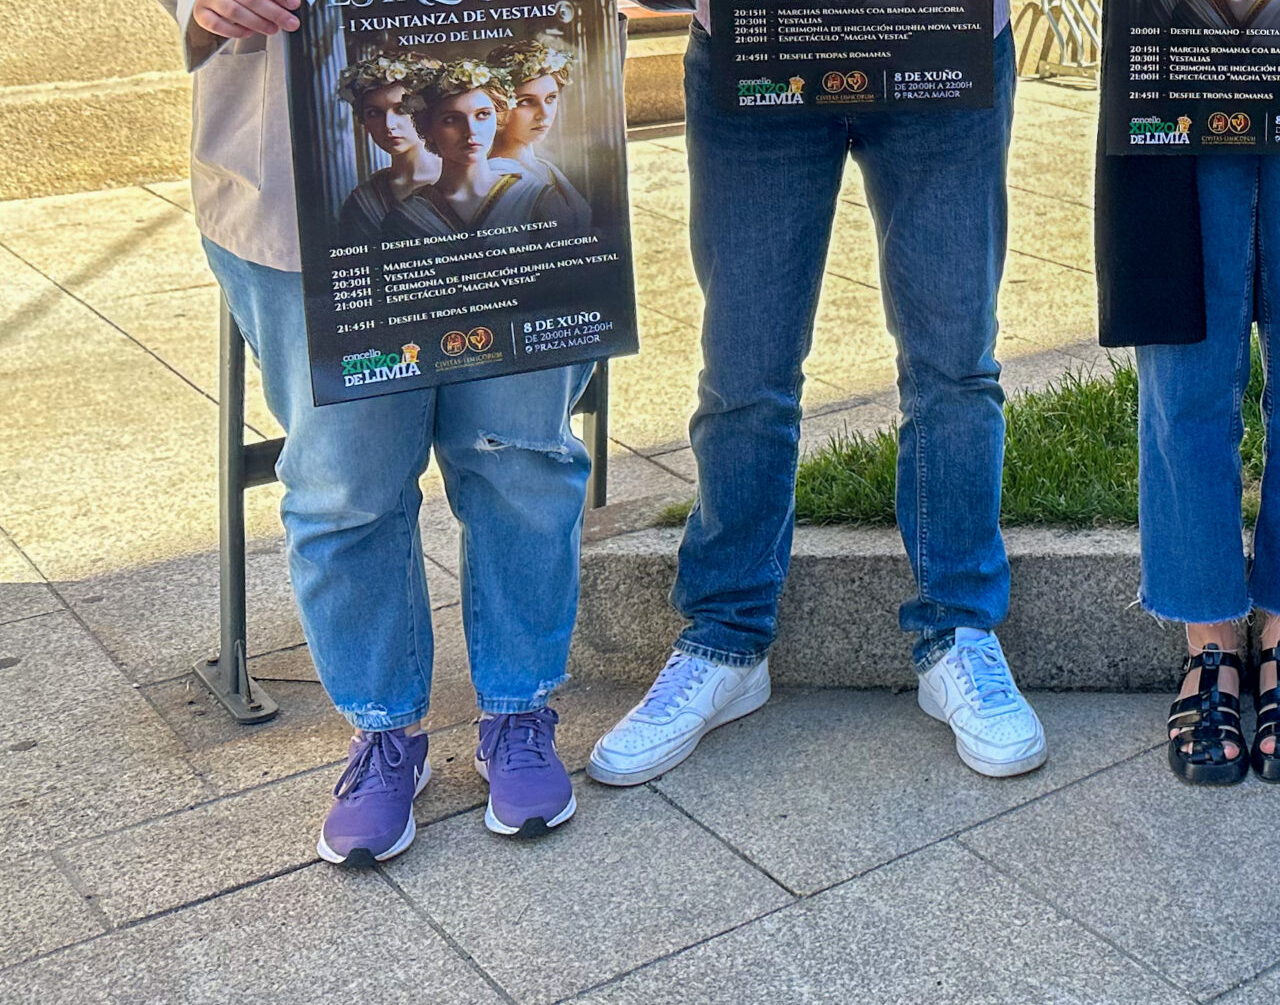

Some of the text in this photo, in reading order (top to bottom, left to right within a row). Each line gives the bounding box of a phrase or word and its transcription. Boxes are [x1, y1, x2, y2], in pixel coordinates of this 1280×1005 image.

[349, 4, 555, 32] I XUNTANZA DE VESTAIS
[398, 27, 512, 46] XINZO DE LIMIA
[894, 69, 962, 81] 8 DE XUÑO
[737, 82, 787, 96] XINZO
[739, 96, 755, 106] DE
[755, 92, 804, 105] LIMIA
[1130, 122, 1174, 134] XINZO
[1131, 132, 1190, 144] DE LIMIA
[329, 220, 557, 257] 20:00H DESFILE ROMANO ESCOLTA VESTAIS
[331, 235, 598, 279] 20:15H MARCHAS ROMANAS COA BANDA ACHICORIA
[332, 267, 436, 290] 20:30H VESTALIAS
[333, 252, 618, 301] 20:45H CERIMONIA DE INICIACIÓN DUNHA NOVA VESTAL
[334, 298, 373, 311] 21:00H
[385, 285, 456, 304] ESPECTÁCULO
[336, 298, 518, 334] 21:45H DESFILE TROPAS ROMANAS
[522, 308, 601, 333] 8 DE XUÑO
[524, 321, 613, 344] DE 20:00H A 22:00H
[534, 333, 601, 352] PRAZA MAIOR
[341, 352, 400, 375] XINZO
[342, 347, 381, 362] concello
[344, 373, 364, 387] DE
[363, 360, 421, 384] LIMIA
